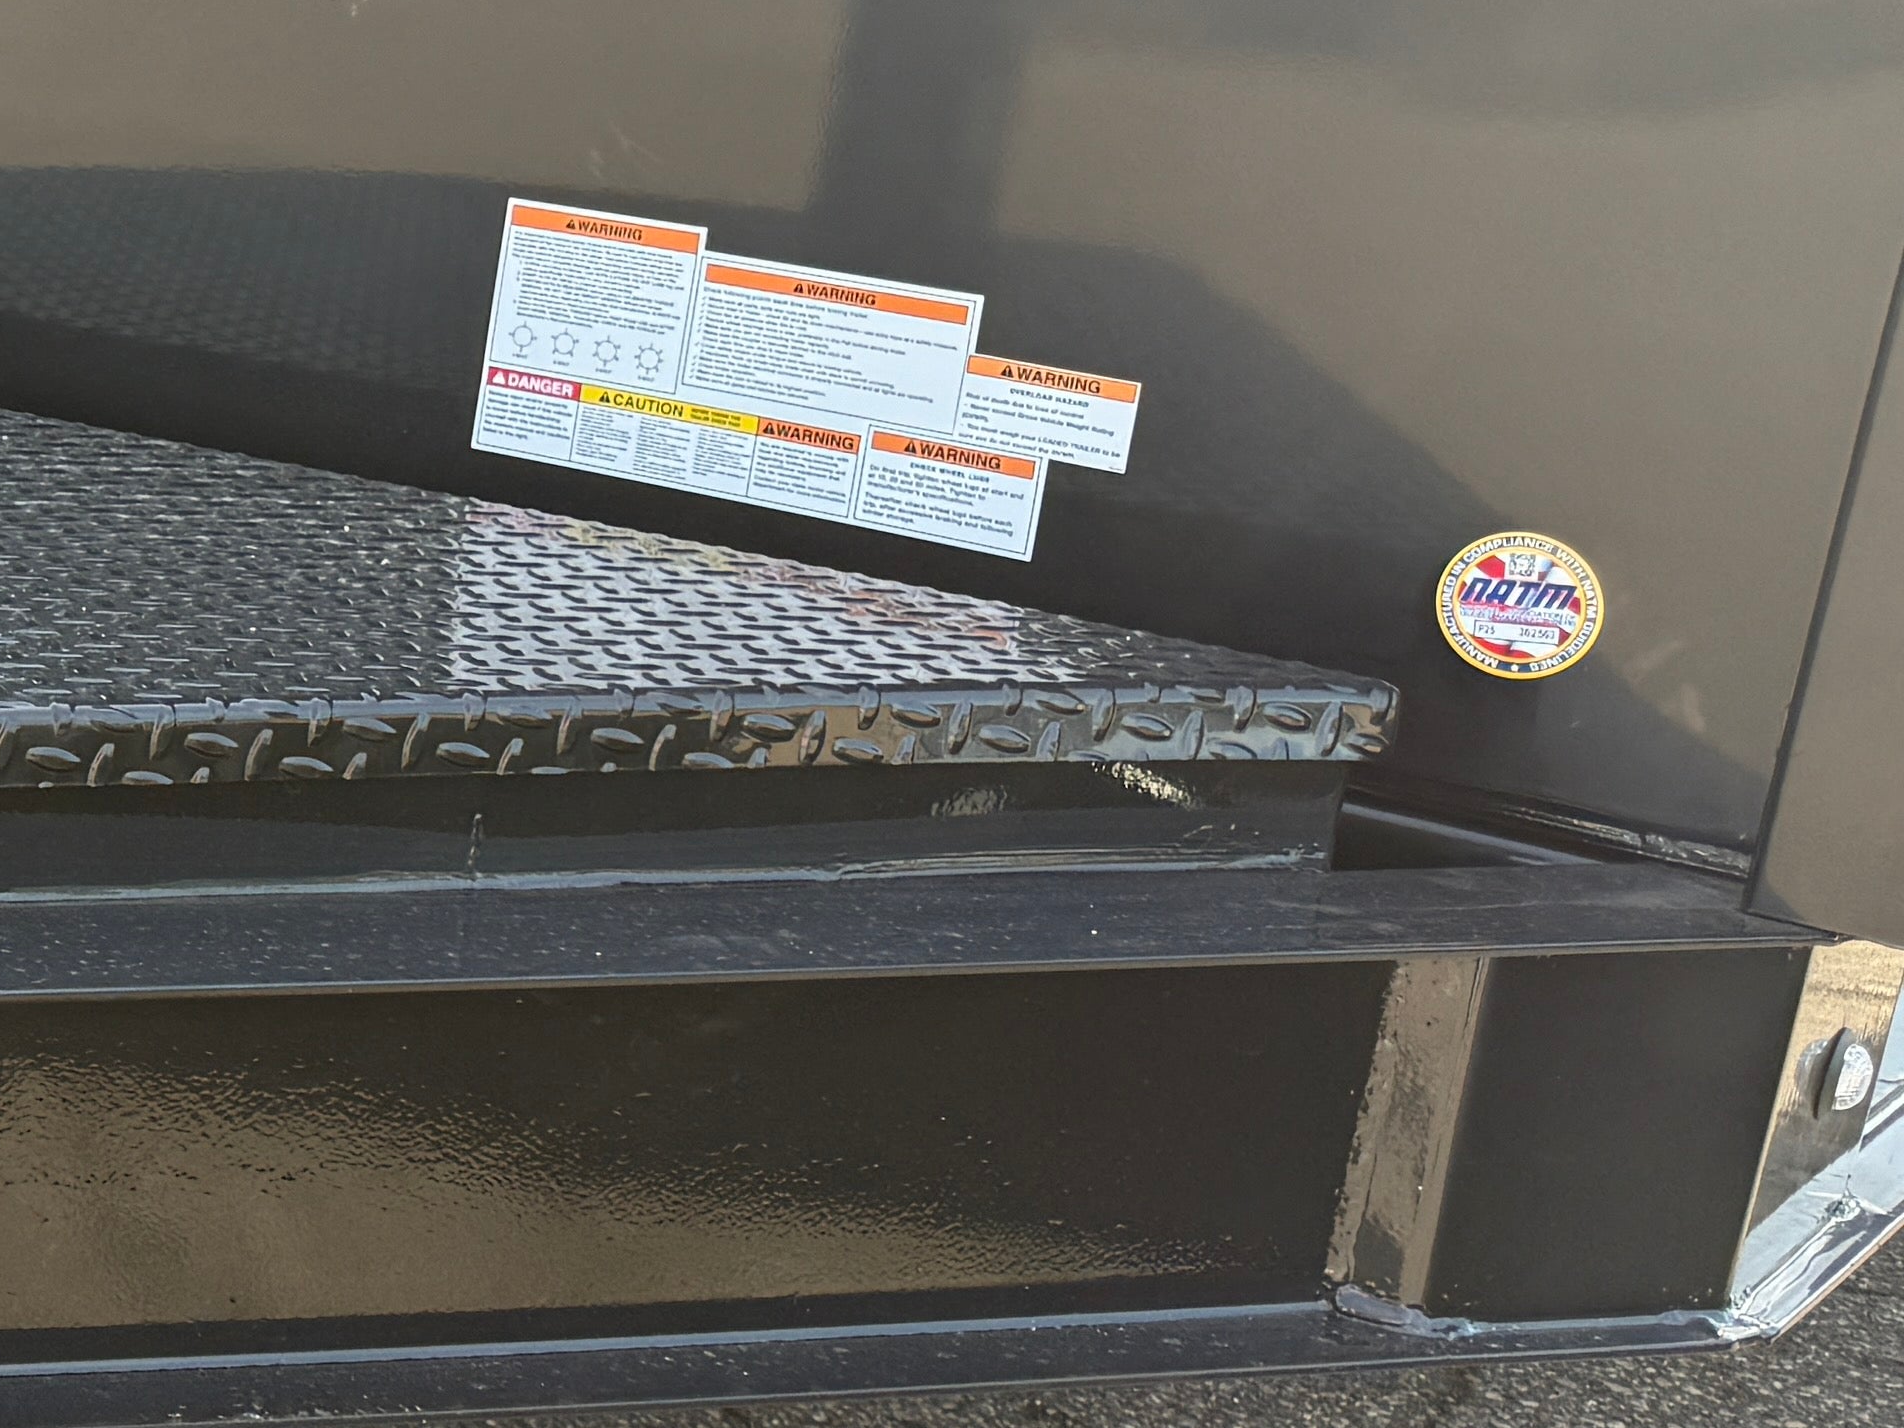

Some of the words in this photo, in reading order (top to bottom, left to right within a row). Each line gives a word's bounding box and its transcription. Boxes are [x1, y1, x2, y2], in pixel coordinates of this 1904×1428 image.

[578, 220, 642, 240] WARNING
[806, 284, 876, 305] WARNING
[1017, 366, 1100, 394] WARNING
[508, 373, 574, 397] DANGER
[613, 393, 683, 417] CAUTION
[777, 424, 853, 450] WARNING
[920, 442, 1001, 470] WARNING
[1464, 536, 1553, 563] COMPLIANCE
[1556, 548, 1585, 579] WITH
[1451, 562, 1465, 577] IN
[1582, 579, 1597, 618] NATM
[1530, 622, 1594, 671] GUIDELINES
